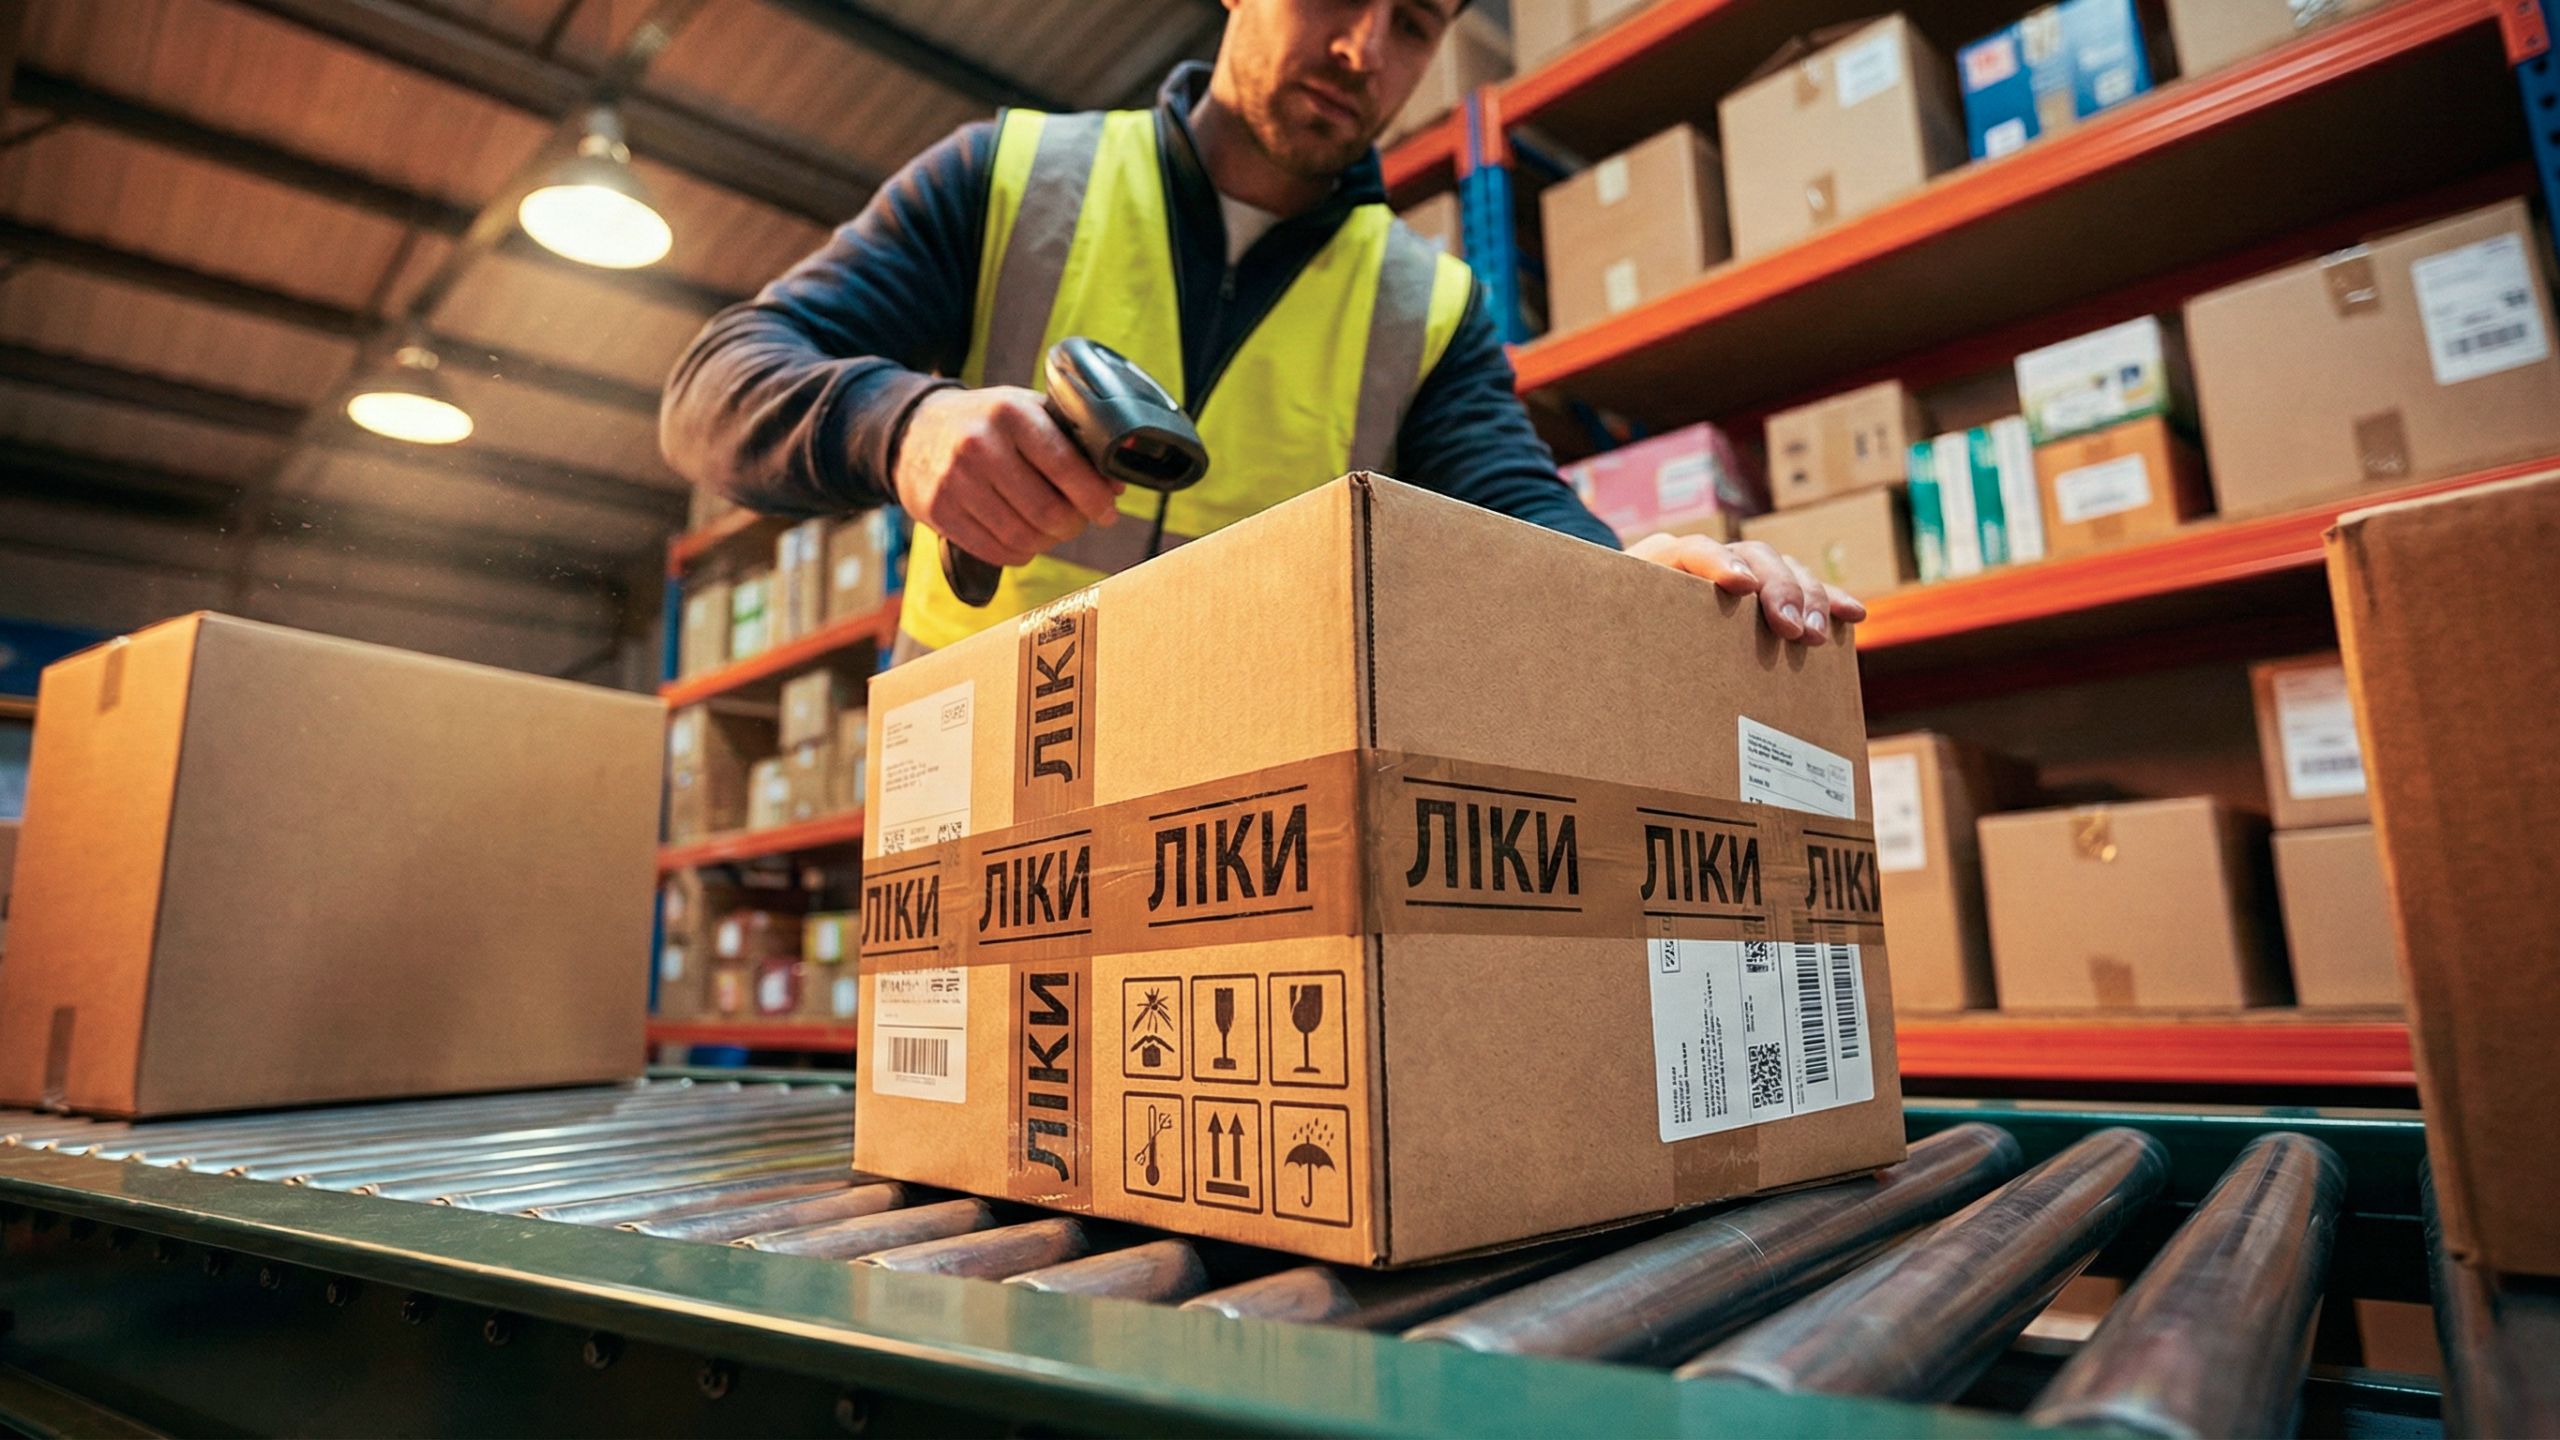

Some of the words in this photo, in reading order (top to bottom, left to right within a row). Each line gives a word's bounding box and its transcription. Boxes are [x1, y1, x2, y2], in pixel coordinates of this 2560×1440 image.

[861, 875, 940, 945] ЛІКИ
[979, 845, 1091, 933] ЛІКИ
[1147, 803, 1309, 912] ЛІКИ
[1405, 798, 1580, 896] ЛІКИ
[1640, 824, 1762, 906] ЛІКИ
[1027, 971, 1070, 1182] ЛІКИ
